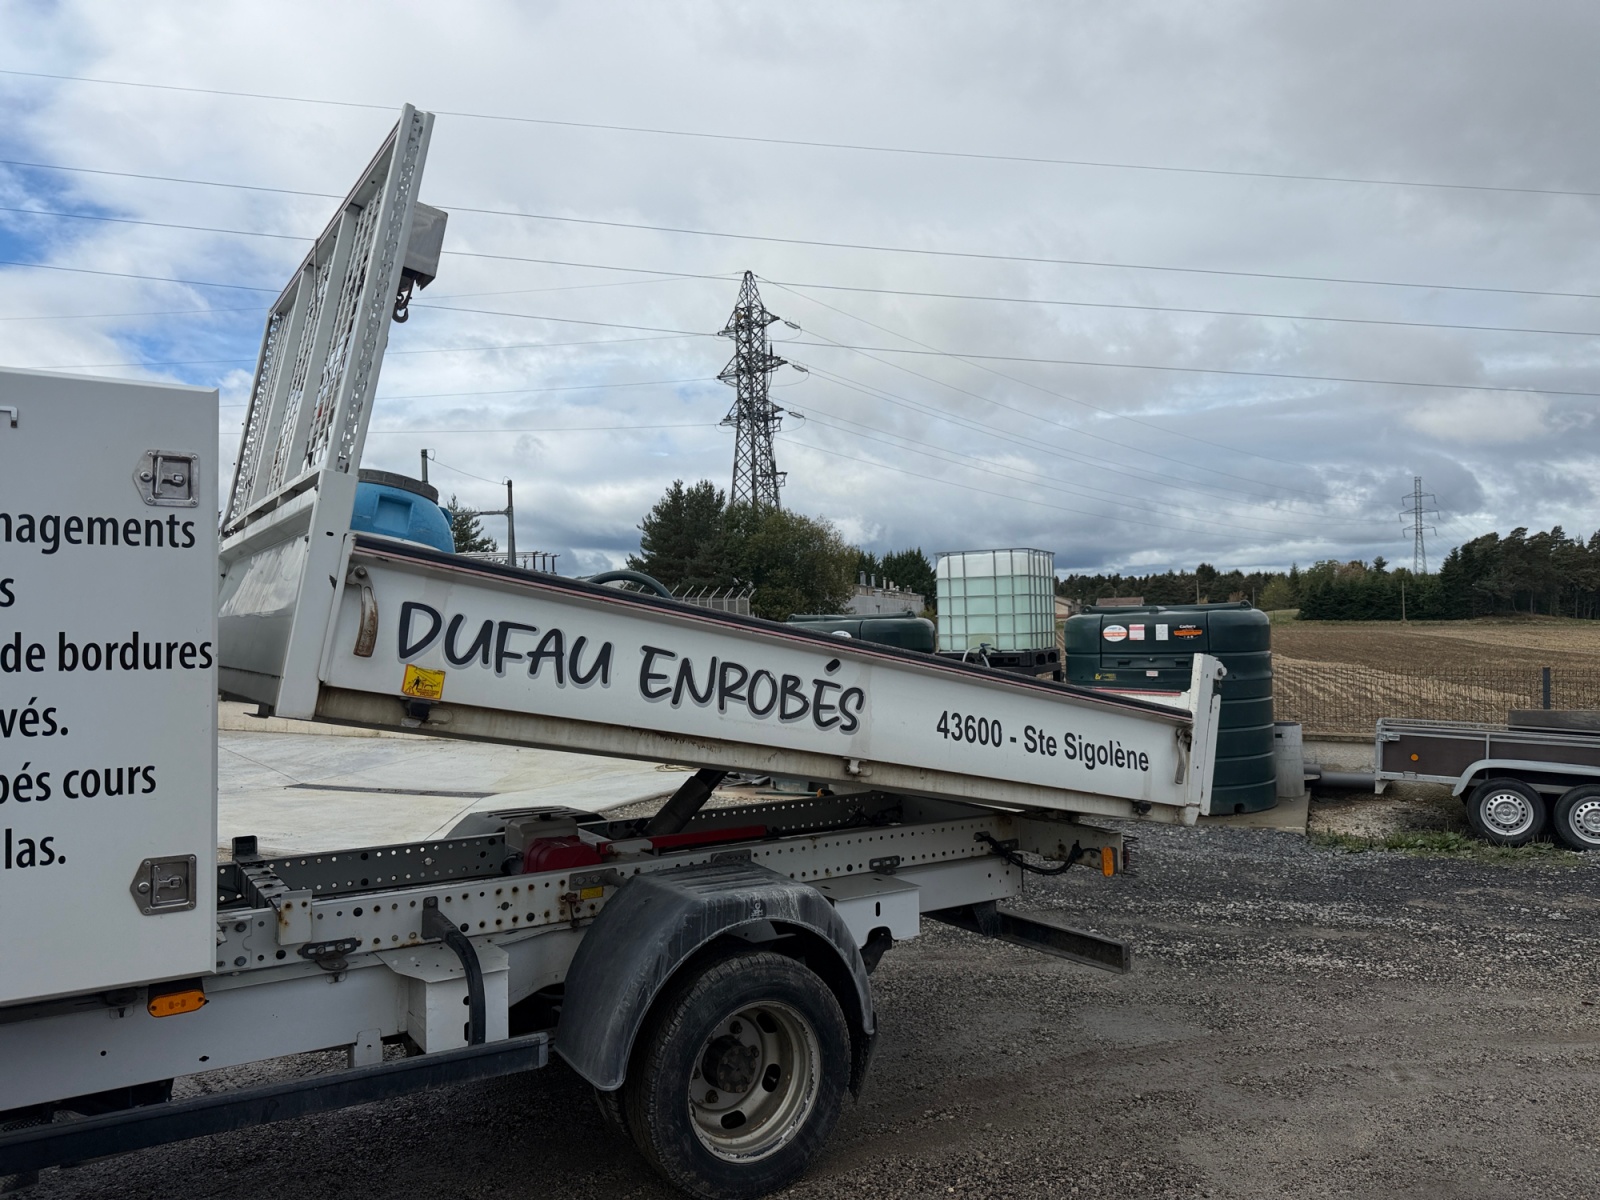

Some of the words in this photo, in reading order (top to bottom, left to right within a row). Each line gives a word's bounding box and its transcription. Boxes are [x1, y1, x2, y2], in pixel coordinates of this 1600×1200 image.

[0, 577, 16, 608] s
[0, 631, 46, 673] de
[58, 631, 213, 672] bordures
[398, 601, 615, 686] DUFAU
[638, 644, 866, 734] ENROBÉS
[0, 696, 69, 738] vés.
[936, 710, 1003, 748] 43600
[1009, 736, 1017, 744] -
[1023, 725, 1058, 757] Ste
[1064, 732, 1149, 772] Sigolène
[62, 765, 157, 800] cours
[4, 827, 67, 870] las.
